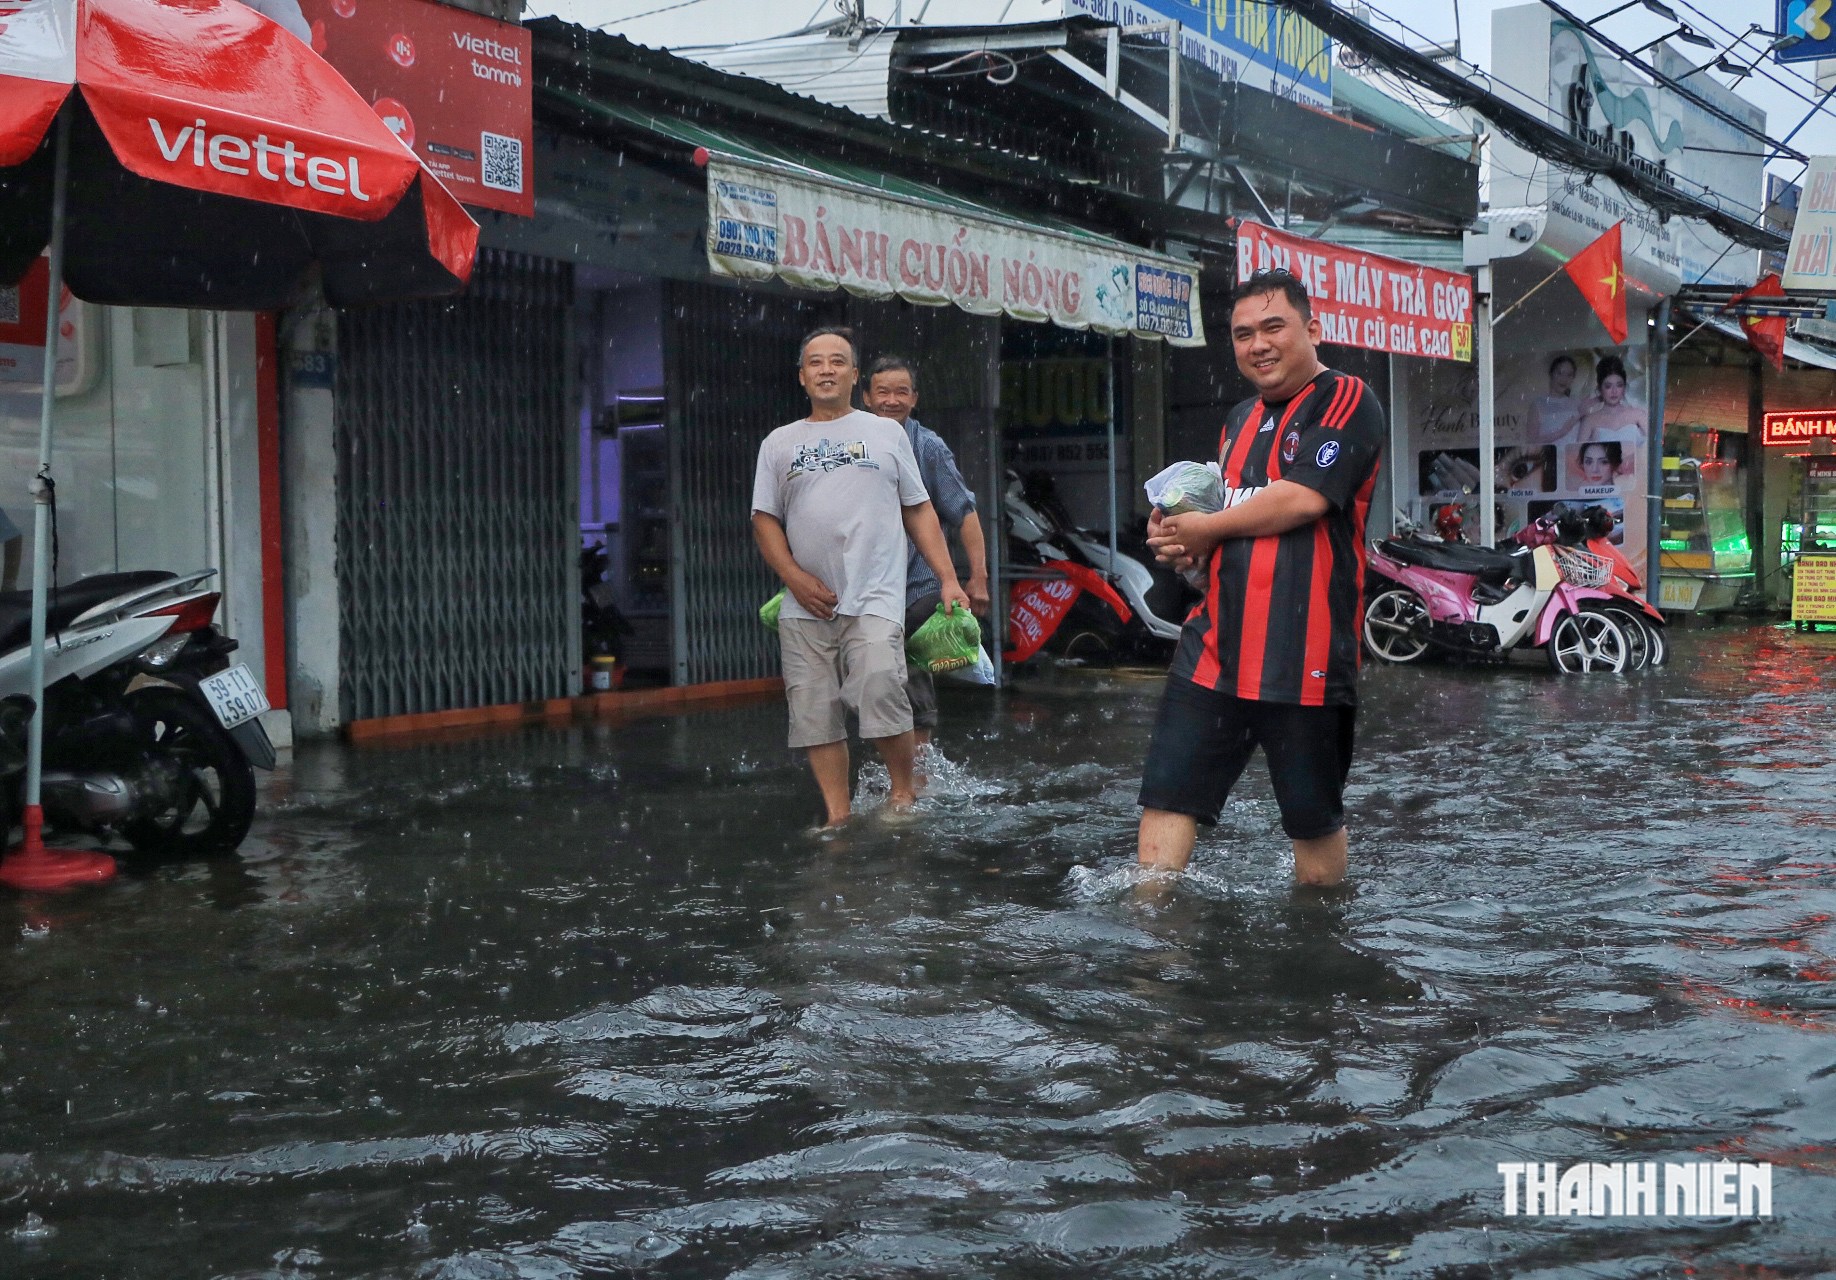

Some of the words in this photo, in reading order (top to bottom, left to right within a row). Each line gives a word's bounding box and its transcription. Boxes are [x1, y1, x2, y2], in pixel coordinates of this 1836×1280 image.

[453, 31, 522, 65] viettel
[148, 118, 369, 201] viettel
[782, 206, 889, 283] BÁNH
[900, 227, 990, 299] CUỐN
[1002, 250, 1080, 314] NÓNG
[1297, 252, 1328, 299] XE
[1335, 257, 1383, 309] MÁY
[1389, 267, 1427, 317] TRẢ
[1433, 276, 1470, 323] GÓP
[1319, 309, 1357, 346] MÁY
[1363, 316, 1386, 349] CŨ
[1390, 321, 1417, 353] GIÁ
[1419, 328, 1450, 357] CAO
[1771, 417, 1821, 436] BÁNH
[1584, 487, 1615, 495] MAKEUP
[210, 669, 250, 701] 59-T1
